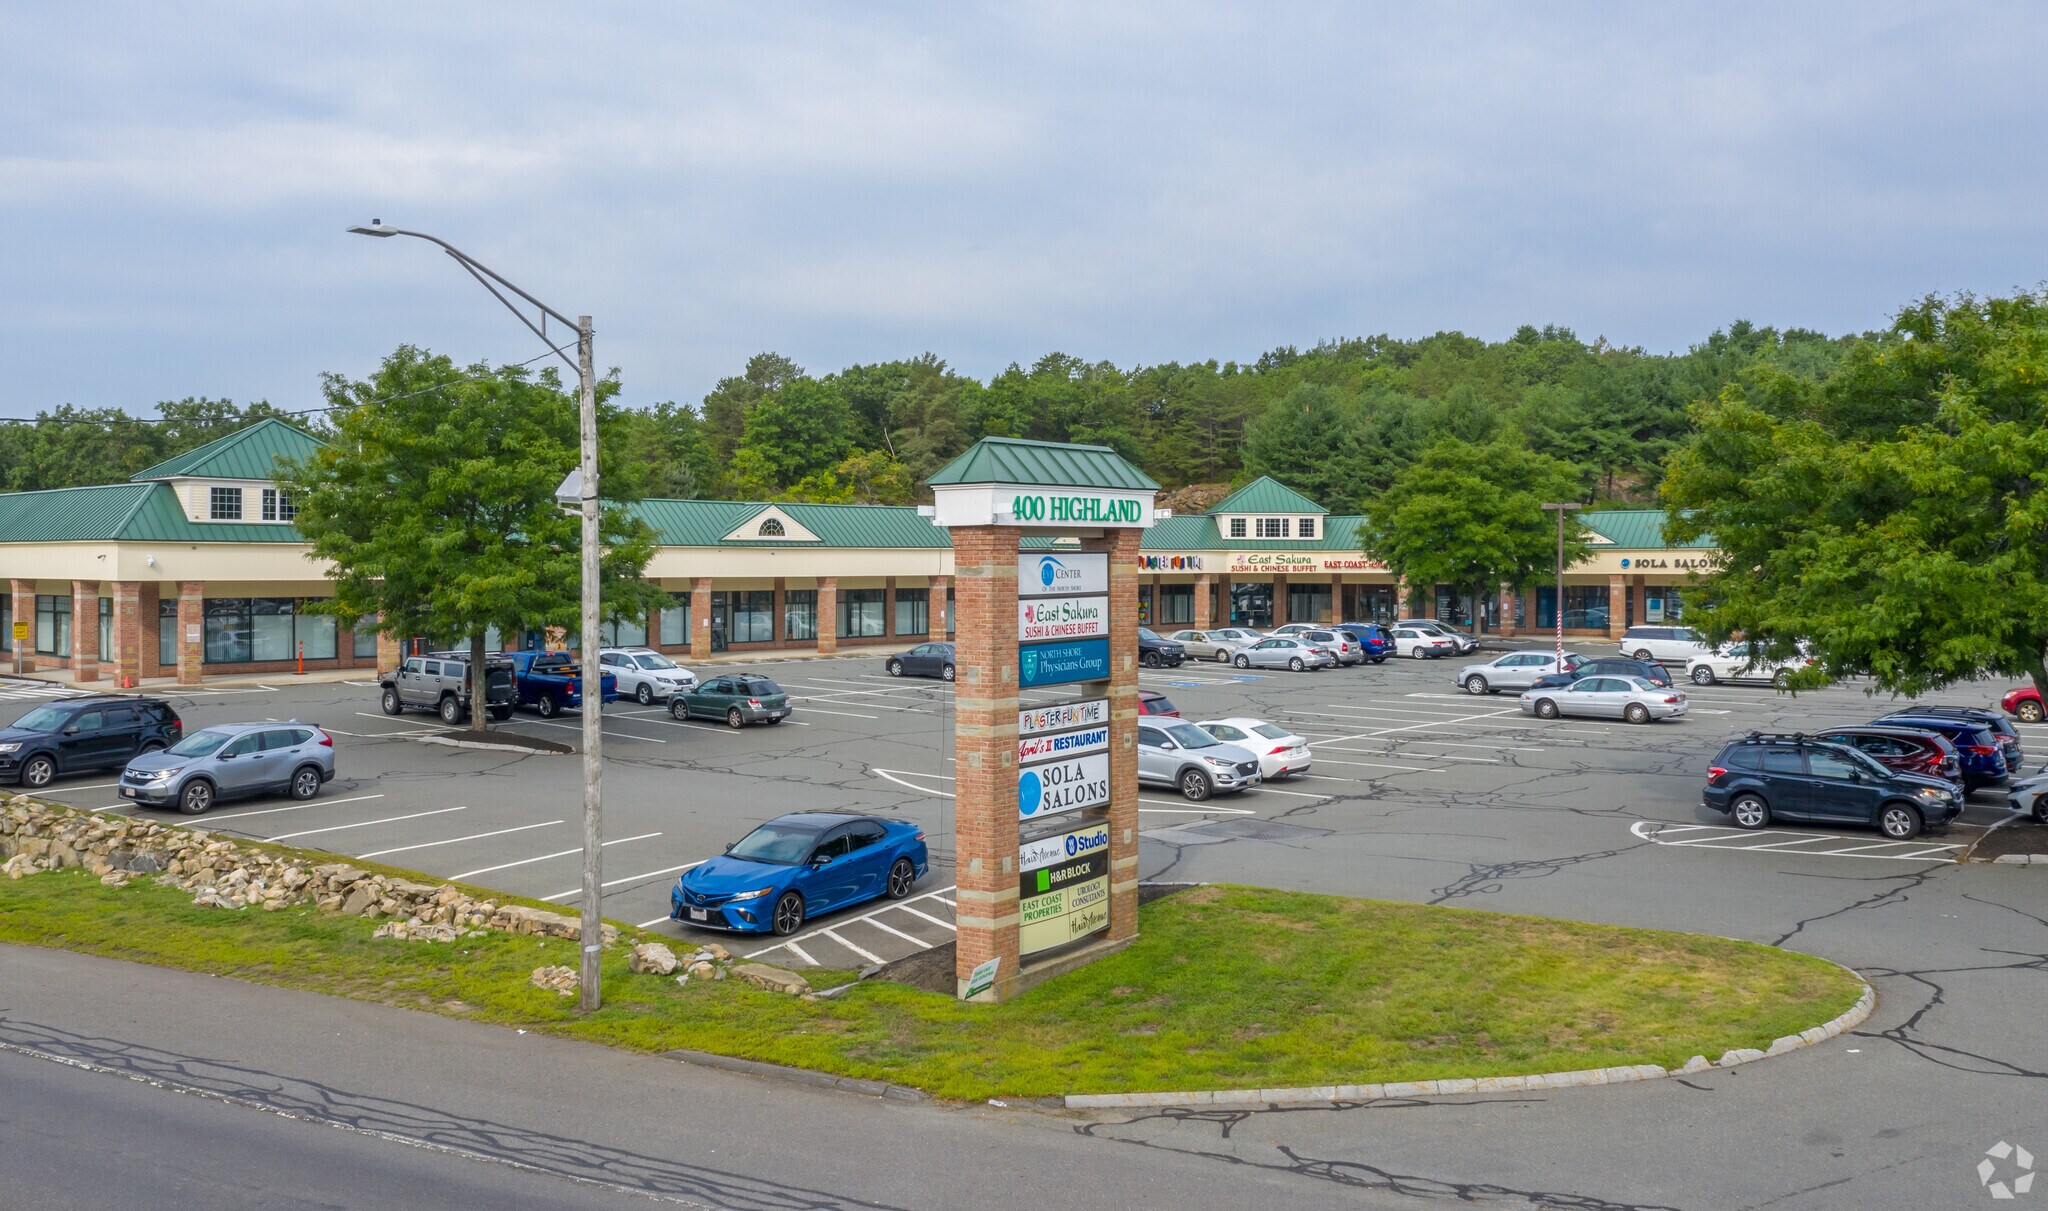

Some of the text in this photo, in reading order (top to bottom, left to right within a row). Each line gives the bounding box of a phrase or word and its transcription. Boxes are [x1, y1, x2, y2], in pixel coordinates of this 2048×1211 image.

[1012, 495, 1142, 523] 400 HIGHLAND
[1248, 554, 1312, 564] East Sakura
[1324, 561, 1341, 569] EAST
[1344, 561, 1367, 569] COAST
[1635, 559, 1724, 568] SOLA SALON
[1056, 569, 1081, 579] CENTER
[1037, 600, 1098, 622] East Sakura
[1025, 622, 1099, 638] SUSHI & CHINESE BUFFET
[1040, 647, 1082, 659] NORTH SHORE
[1041, 657, 1102, 676] Physicians Group
[1024, 704, 1099, 730] PLASTER FUN TIME
[1018, 738, 1045, 762] April's
[1054, 730, 1107, 751] RESTAURANT
[1043, 762, 1085, 787] SOLA
[1043, 780, 1107, 811] SALONS
[1078, 830, 1108, 851] Studio
[1067, 862, 1091, 879] BLOCK
[1022, 893, 1062, 912] EAST COAST
[1071, 889, 1106, 907] CONSULTANTS
[1024, 904, 1062, 921] PROPERTIES
